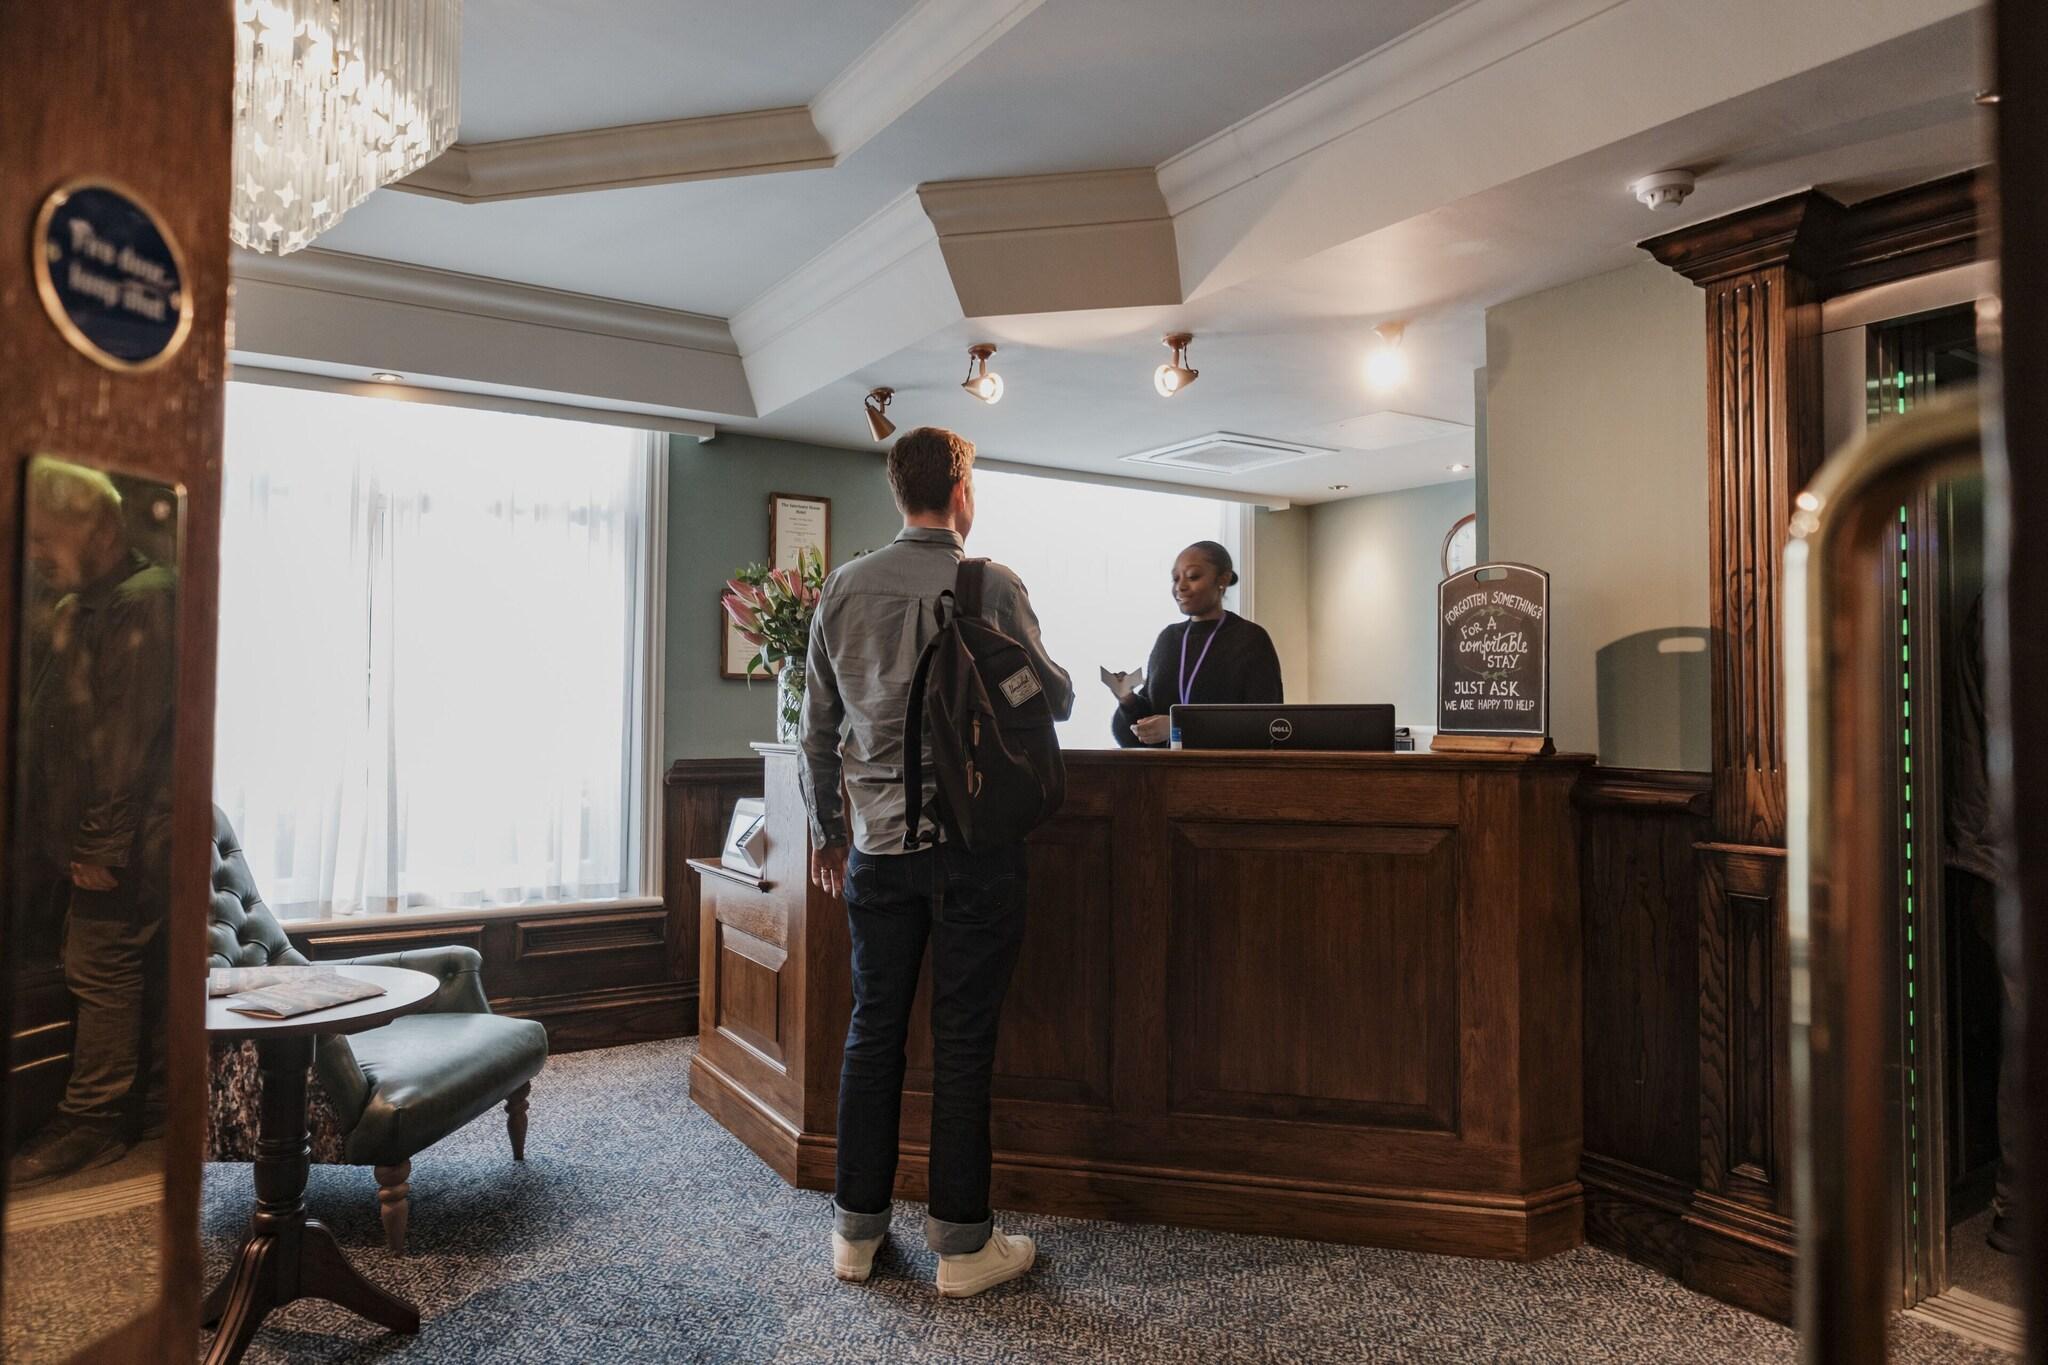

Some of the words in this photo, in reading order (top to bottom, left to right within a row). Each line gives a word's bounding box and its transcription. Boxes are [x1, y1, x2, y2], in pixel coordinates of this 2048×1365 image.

[1444, 592, 1488, 626] FORGOTTEN
[1491, 591, 1543, 620] SOMETHING?
[1460, 622, 1483, 640] FOR
[1486, 615, 1497, 630] A
[1459, 632, 1528, 661] comfortable
[1487, 654, 1520, 669] STAY
[1454, 680, 1486, 695] JUST
[1489, 680, 1520, 697] ASK
[1444, 700, 1458, 711] WE
[1460, 699, 1475, 711] ARE
[1478, 698, 1501, 710] HAPPY
[1503, 699, 1514, 710] TO
[1516, 700, 1535, 711] HELP
